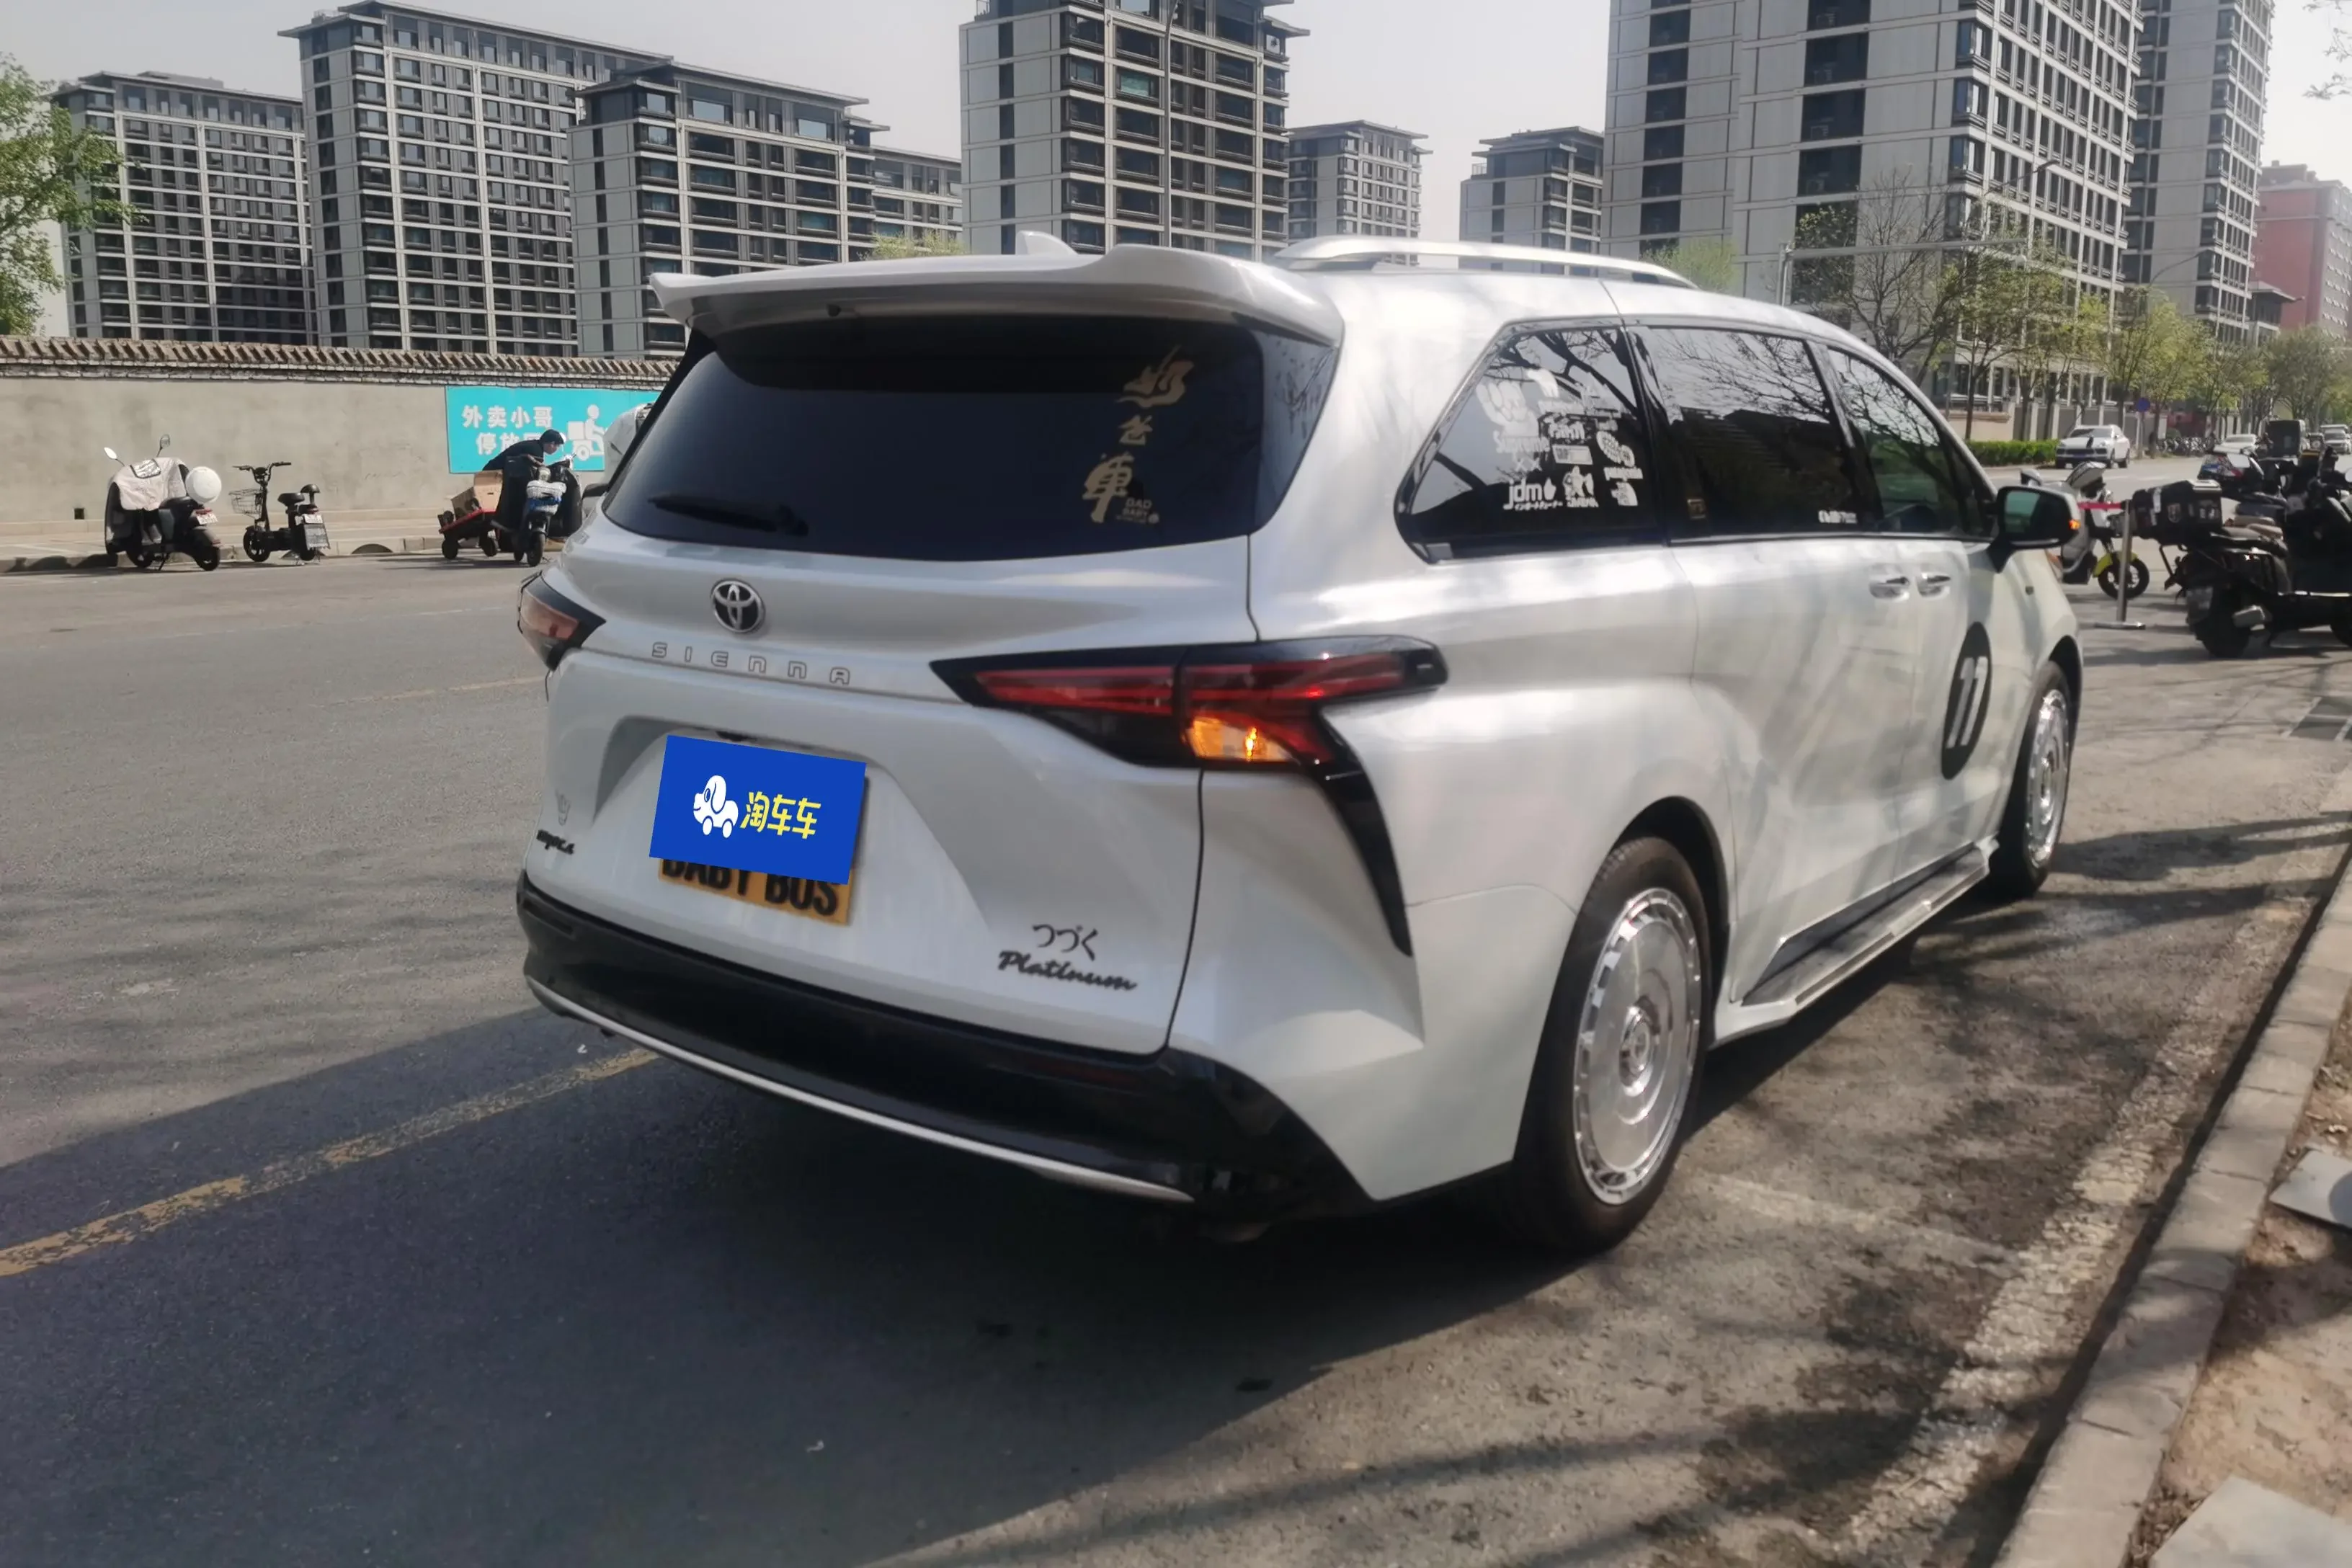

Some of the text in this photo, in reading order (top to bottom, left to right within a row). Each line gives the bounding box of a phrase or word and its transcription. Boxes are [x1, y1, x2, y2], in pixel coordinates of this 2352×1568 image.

[461, 405, 553, 429] 外卖小哥
[1502, 478, 1542, 509] jdm
[651, 641, 851, 685] SIENNA
[1031, 924, 1098, 962] つづく
[998, 950, 1138, 991] Platinum
